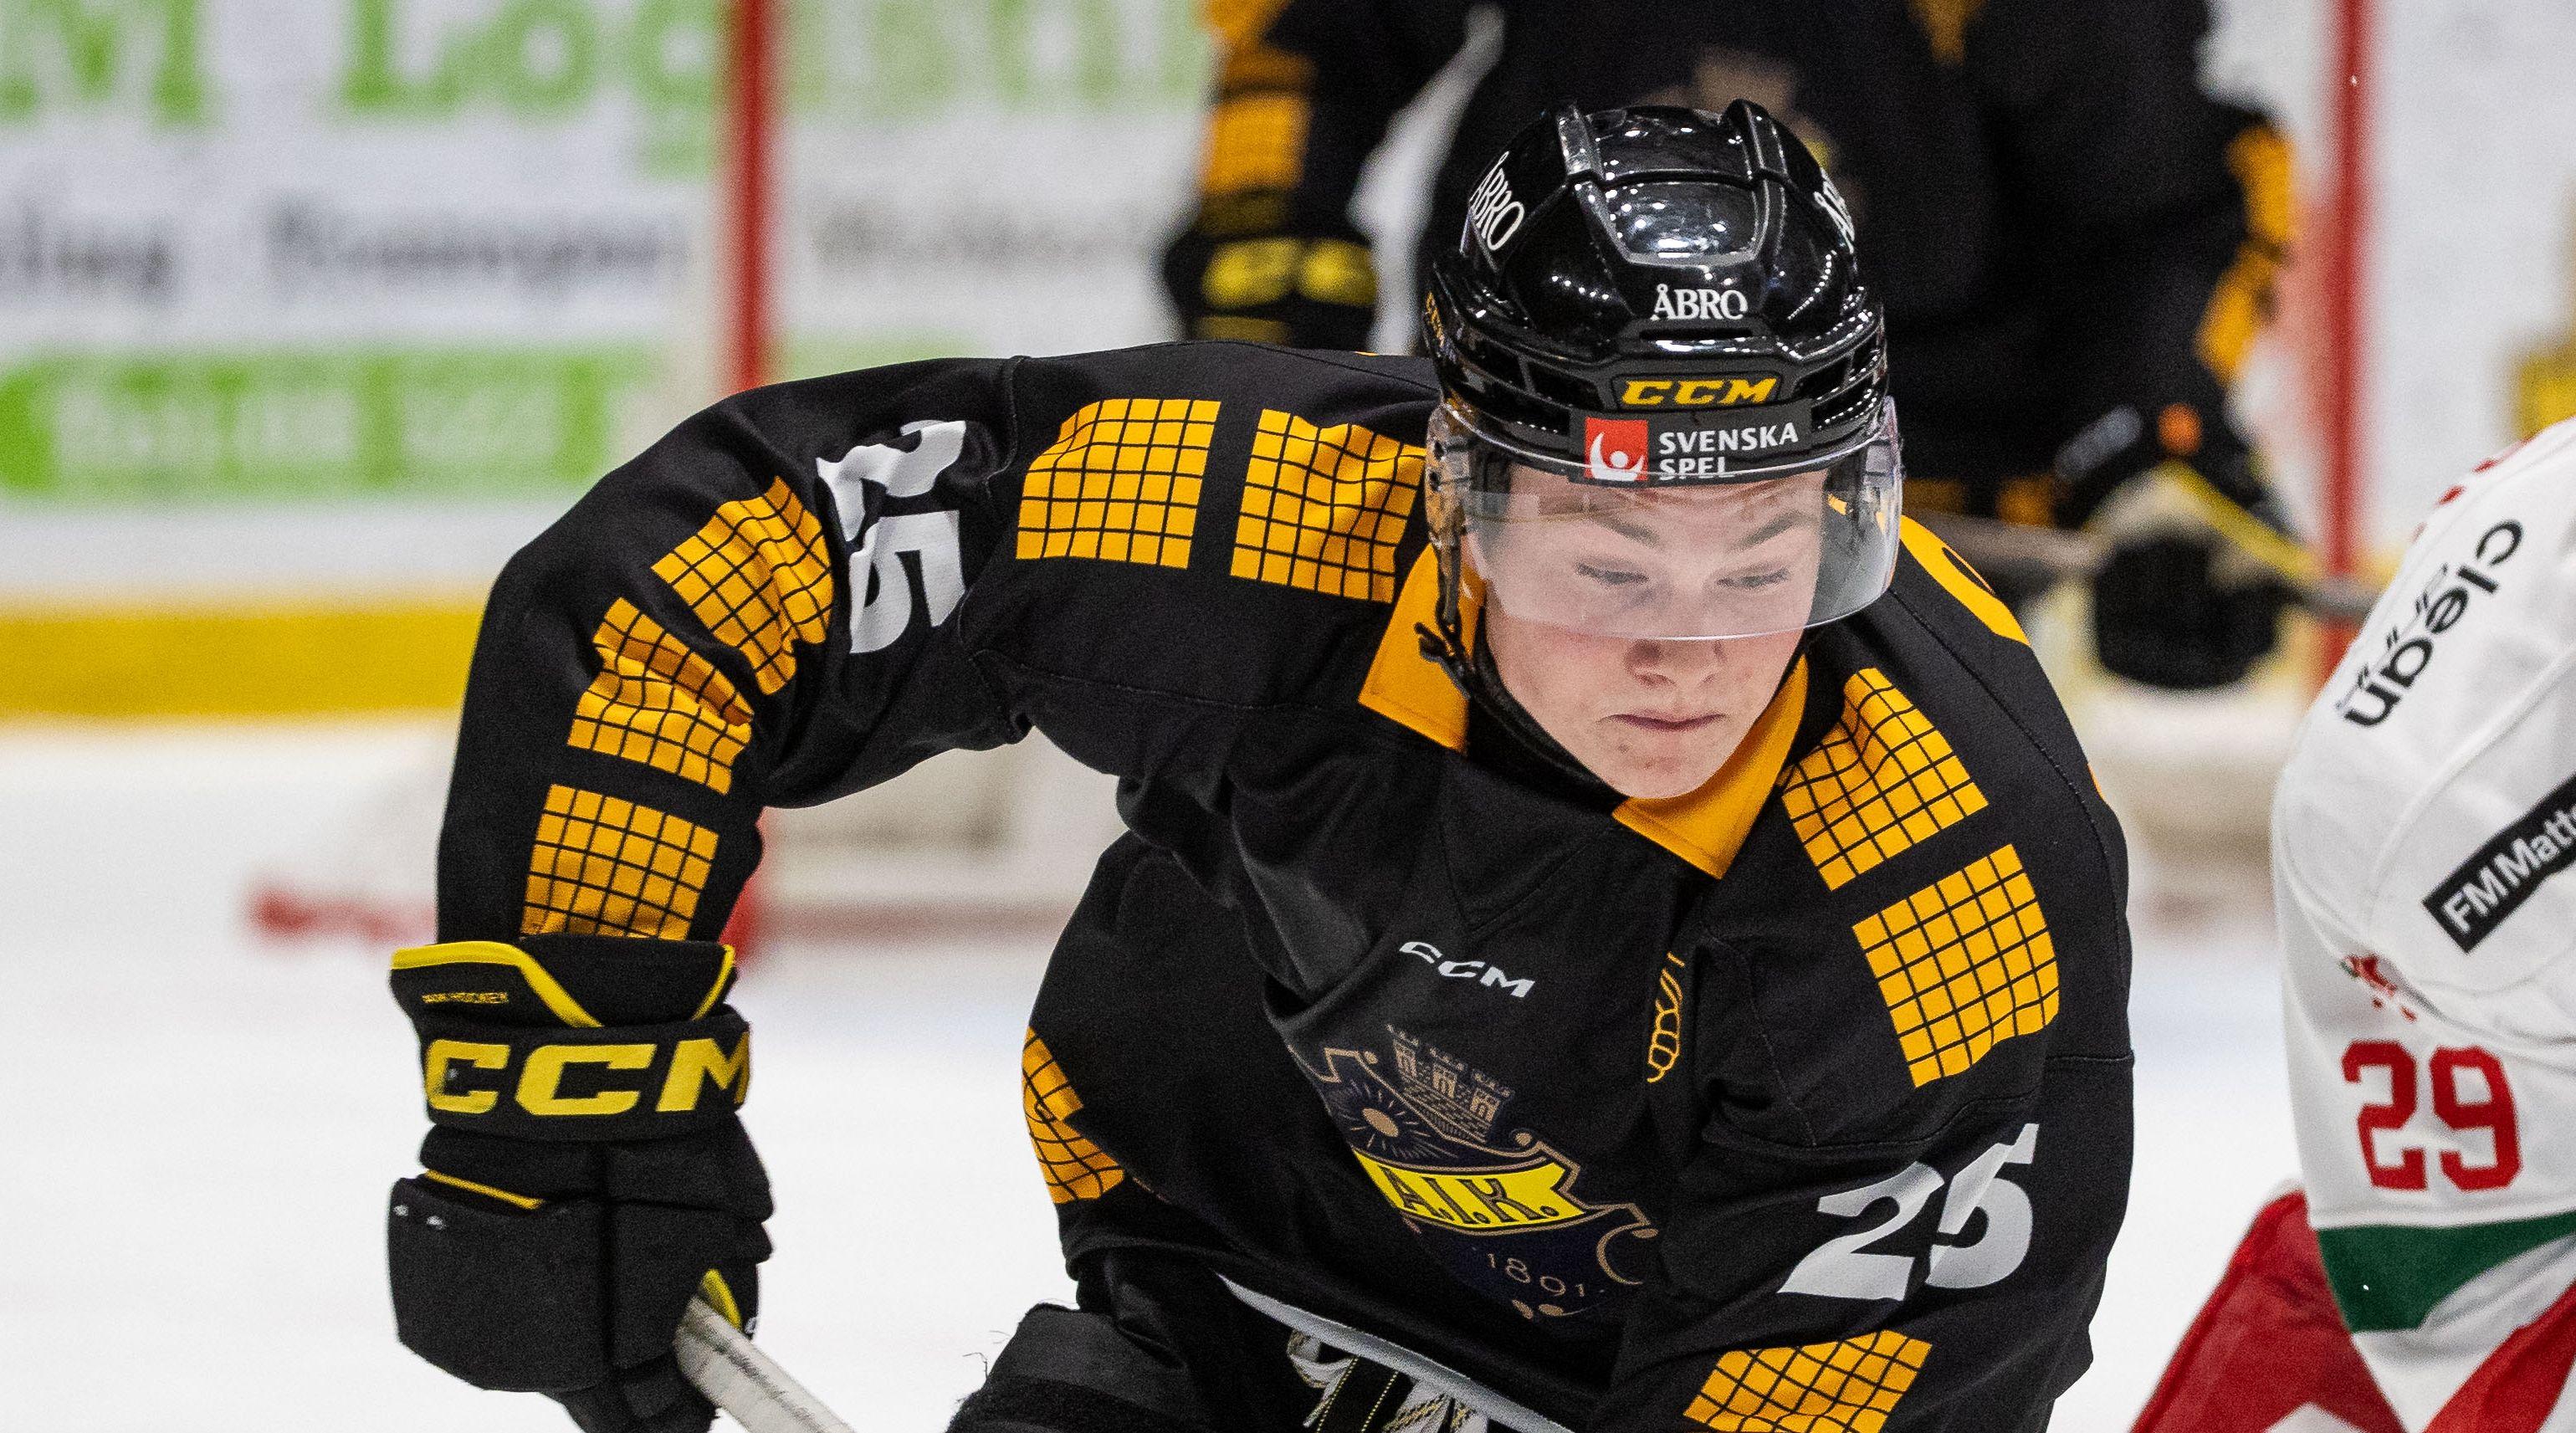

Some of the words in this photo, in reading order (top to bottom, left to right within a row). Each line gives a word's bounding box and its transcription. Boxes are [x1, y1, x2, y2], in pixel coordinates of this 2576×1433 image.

[1650, 283, 1749, 321] ÅBRO
[1621, 377, 1777, 406] CCM
[1658, 422, 1799, 455] SVENSKA
[1658, 456, 1736, 481] SPEL
[2343, 518, 2525, 729] clean
[1398, 941, 1536, 999] CCM
[424, 1031, 750, 1116] CCM
[2341, 1039, 2523, 1191] 29
[1777, 1122, 2040, 1302] 25
